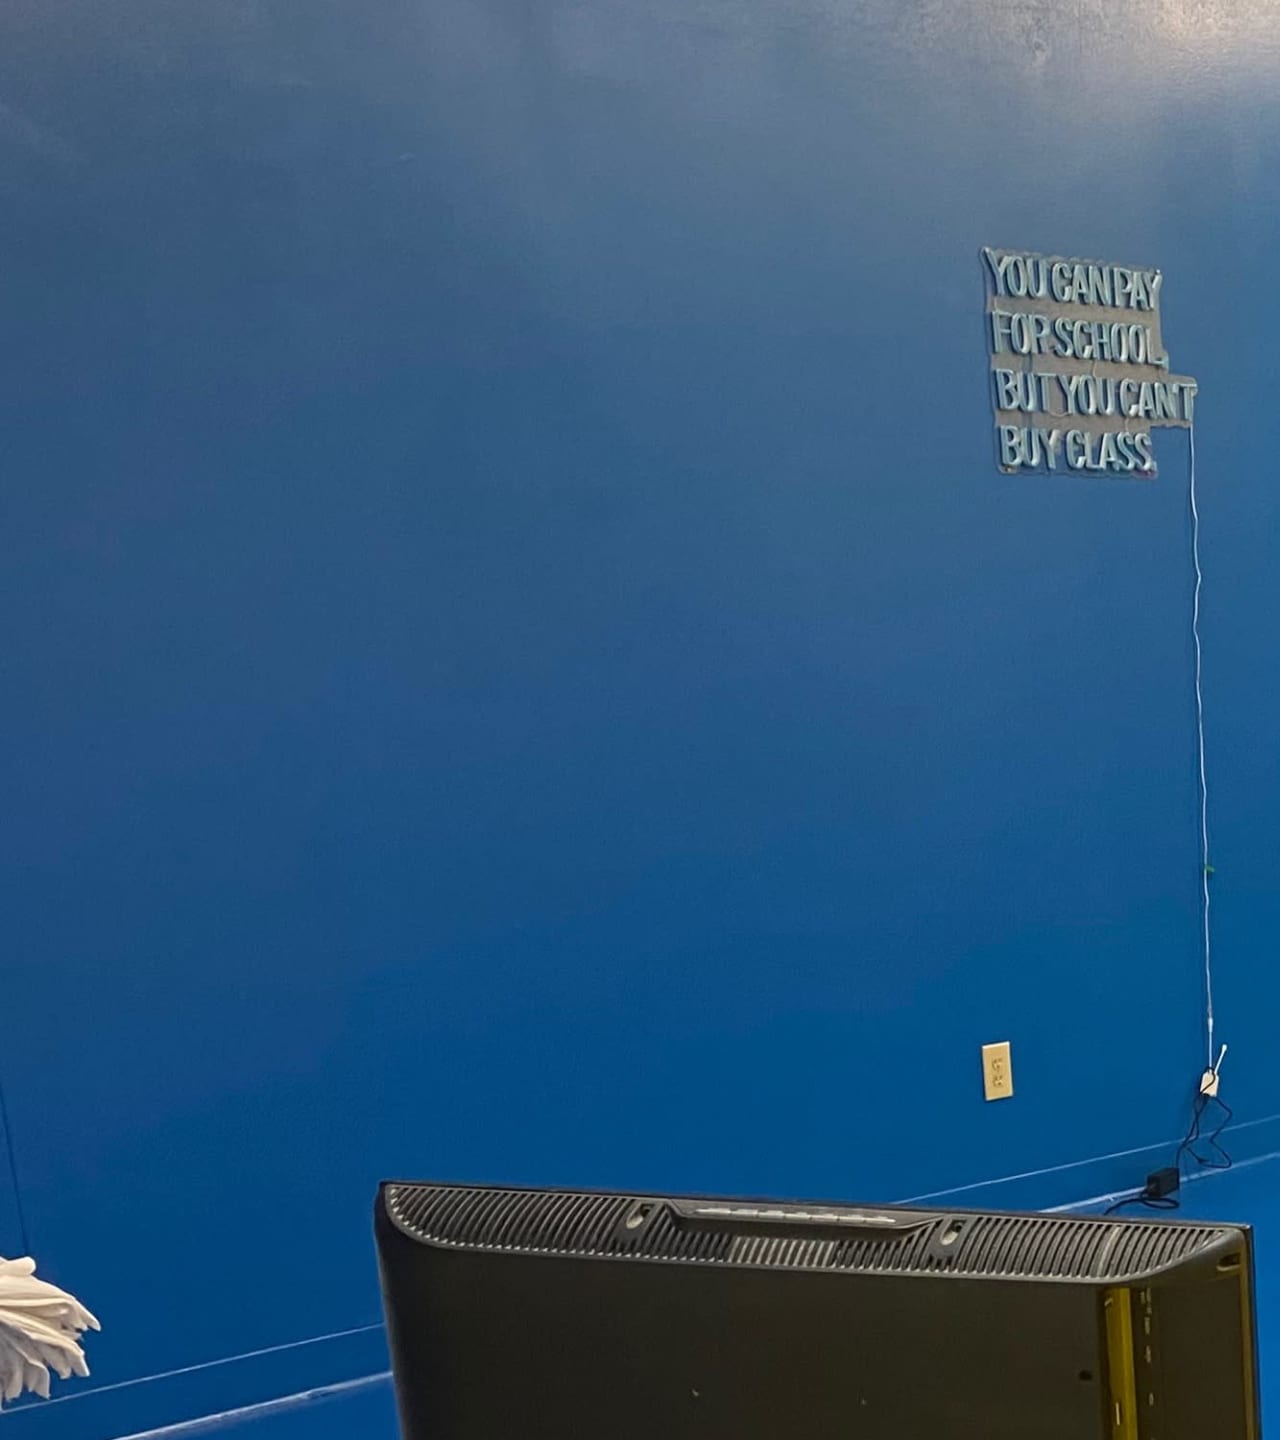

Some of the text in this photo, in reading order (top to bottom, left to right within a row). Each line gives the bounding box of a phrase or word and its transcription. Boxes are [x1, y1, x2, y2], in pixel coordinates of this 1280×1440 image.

[983, 247, 1162, 311] YOU CAN PAY
[992, 311, 1050, 355] FOR
[994, 368, 1056, 412] BUT
[1058, 374, 1116, 416] YOU
[1000, 425, 1060, 470] BUY
